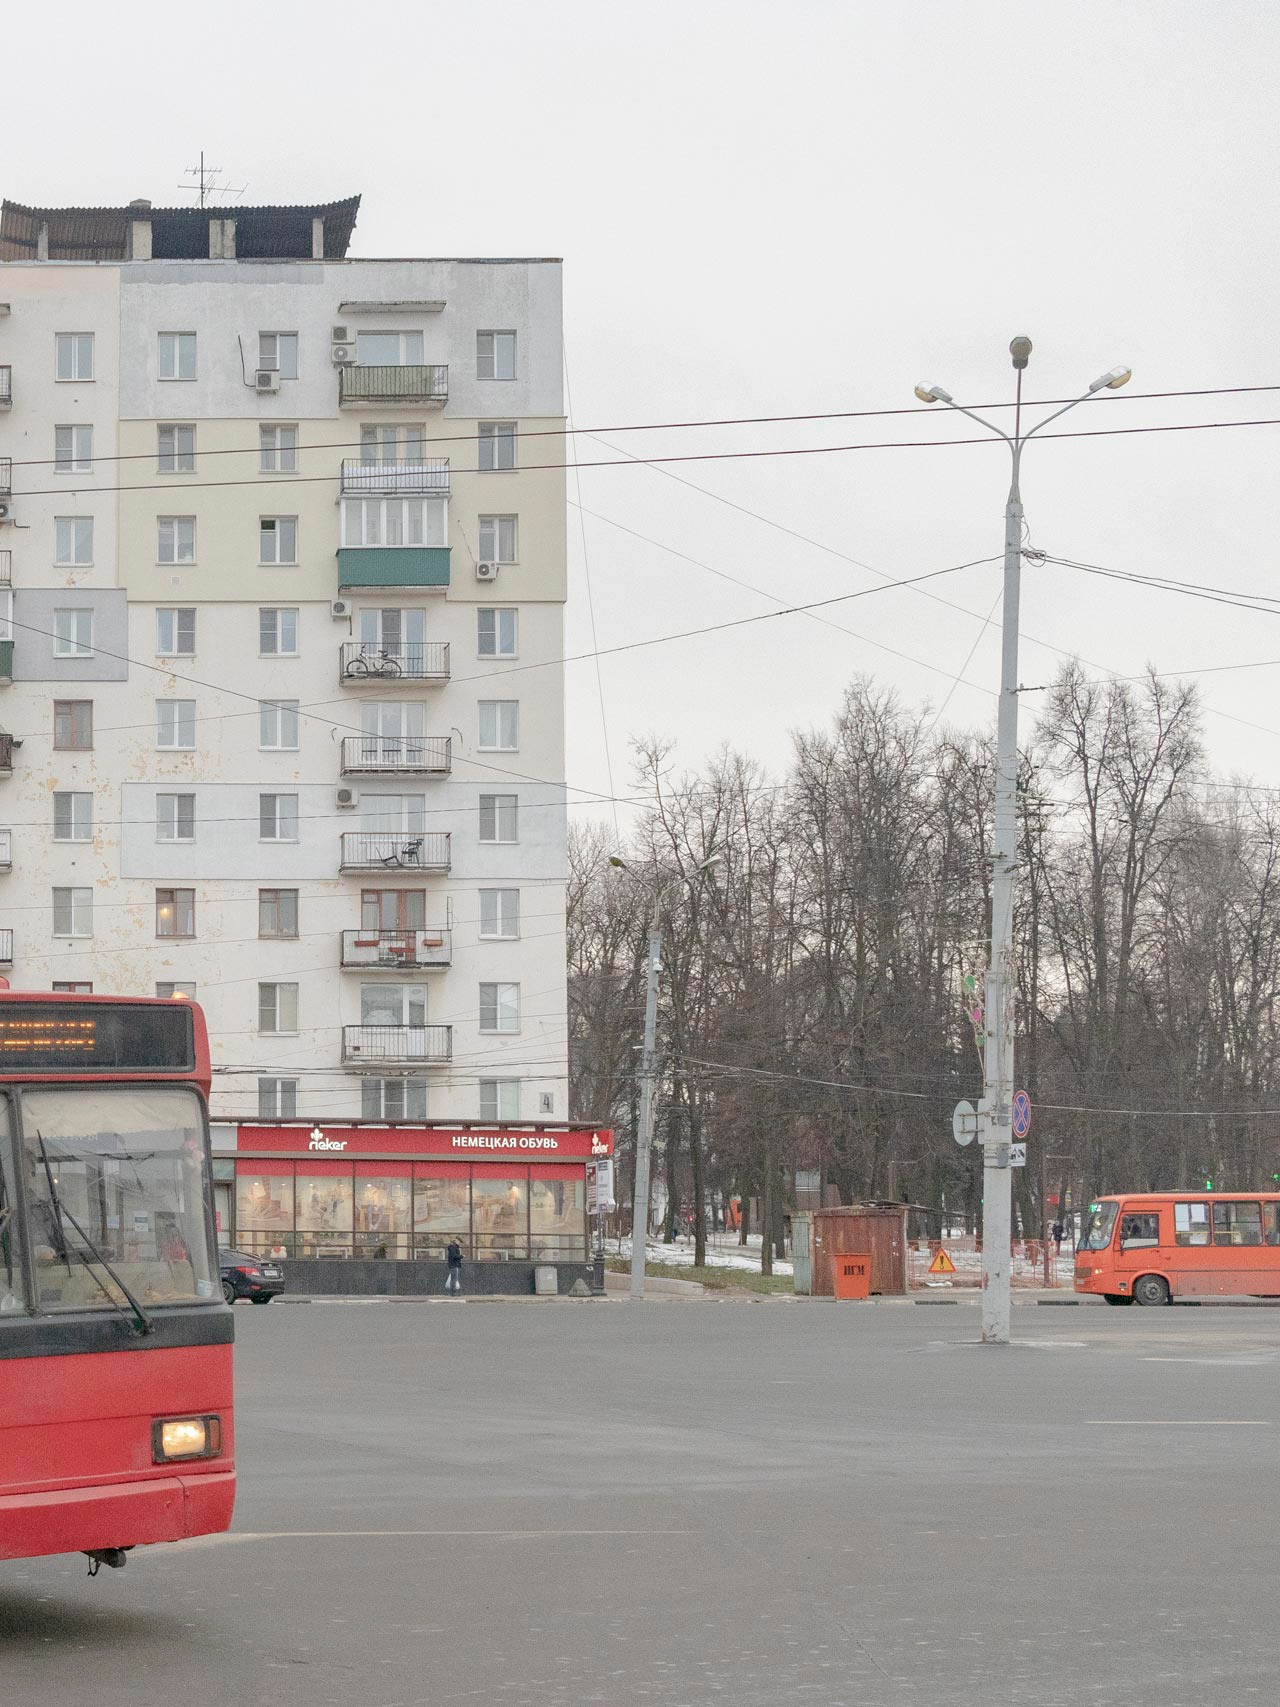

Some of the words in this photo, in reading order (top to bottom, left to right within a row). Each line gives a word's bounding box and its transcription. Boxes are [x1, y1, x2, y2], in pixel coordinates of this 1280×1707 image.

[543, 1094, 550, 1110] 4
[308, 1137, 348, 1151] rieker
[452, 1136, 517, 1149] НЕМЕЦКАЯ
[519, 1138, 558, 1149] ОБУВЬ
